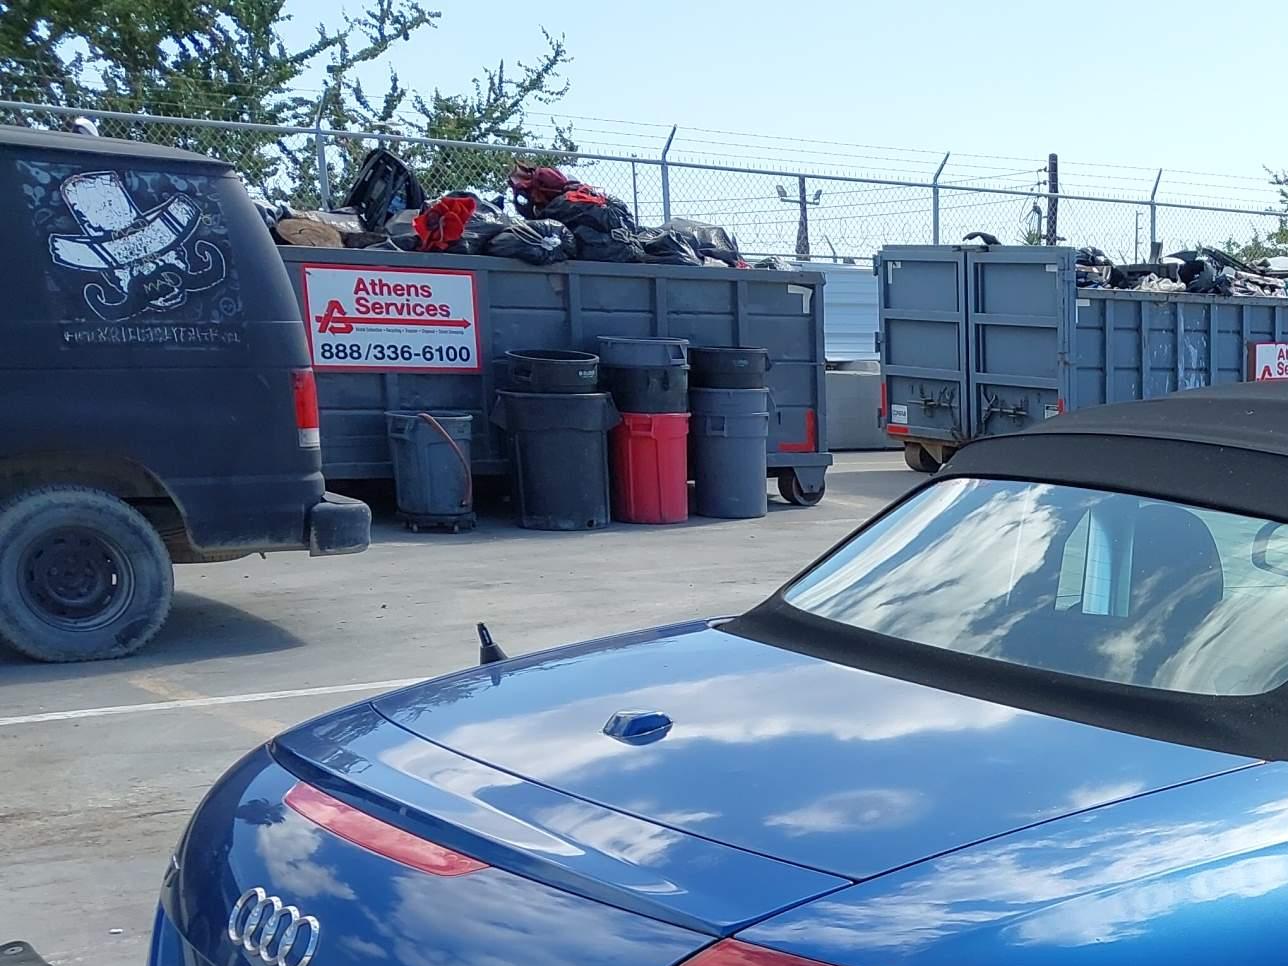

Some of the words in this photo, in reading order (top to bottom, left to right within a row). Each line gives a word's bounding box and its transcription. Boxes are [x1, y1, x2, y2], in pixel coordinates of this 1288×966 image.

[353, 277, 432, 298] Athens
[355, 297, 451, 317] Services
[320, 342, 471, 362] 888/336-6100
